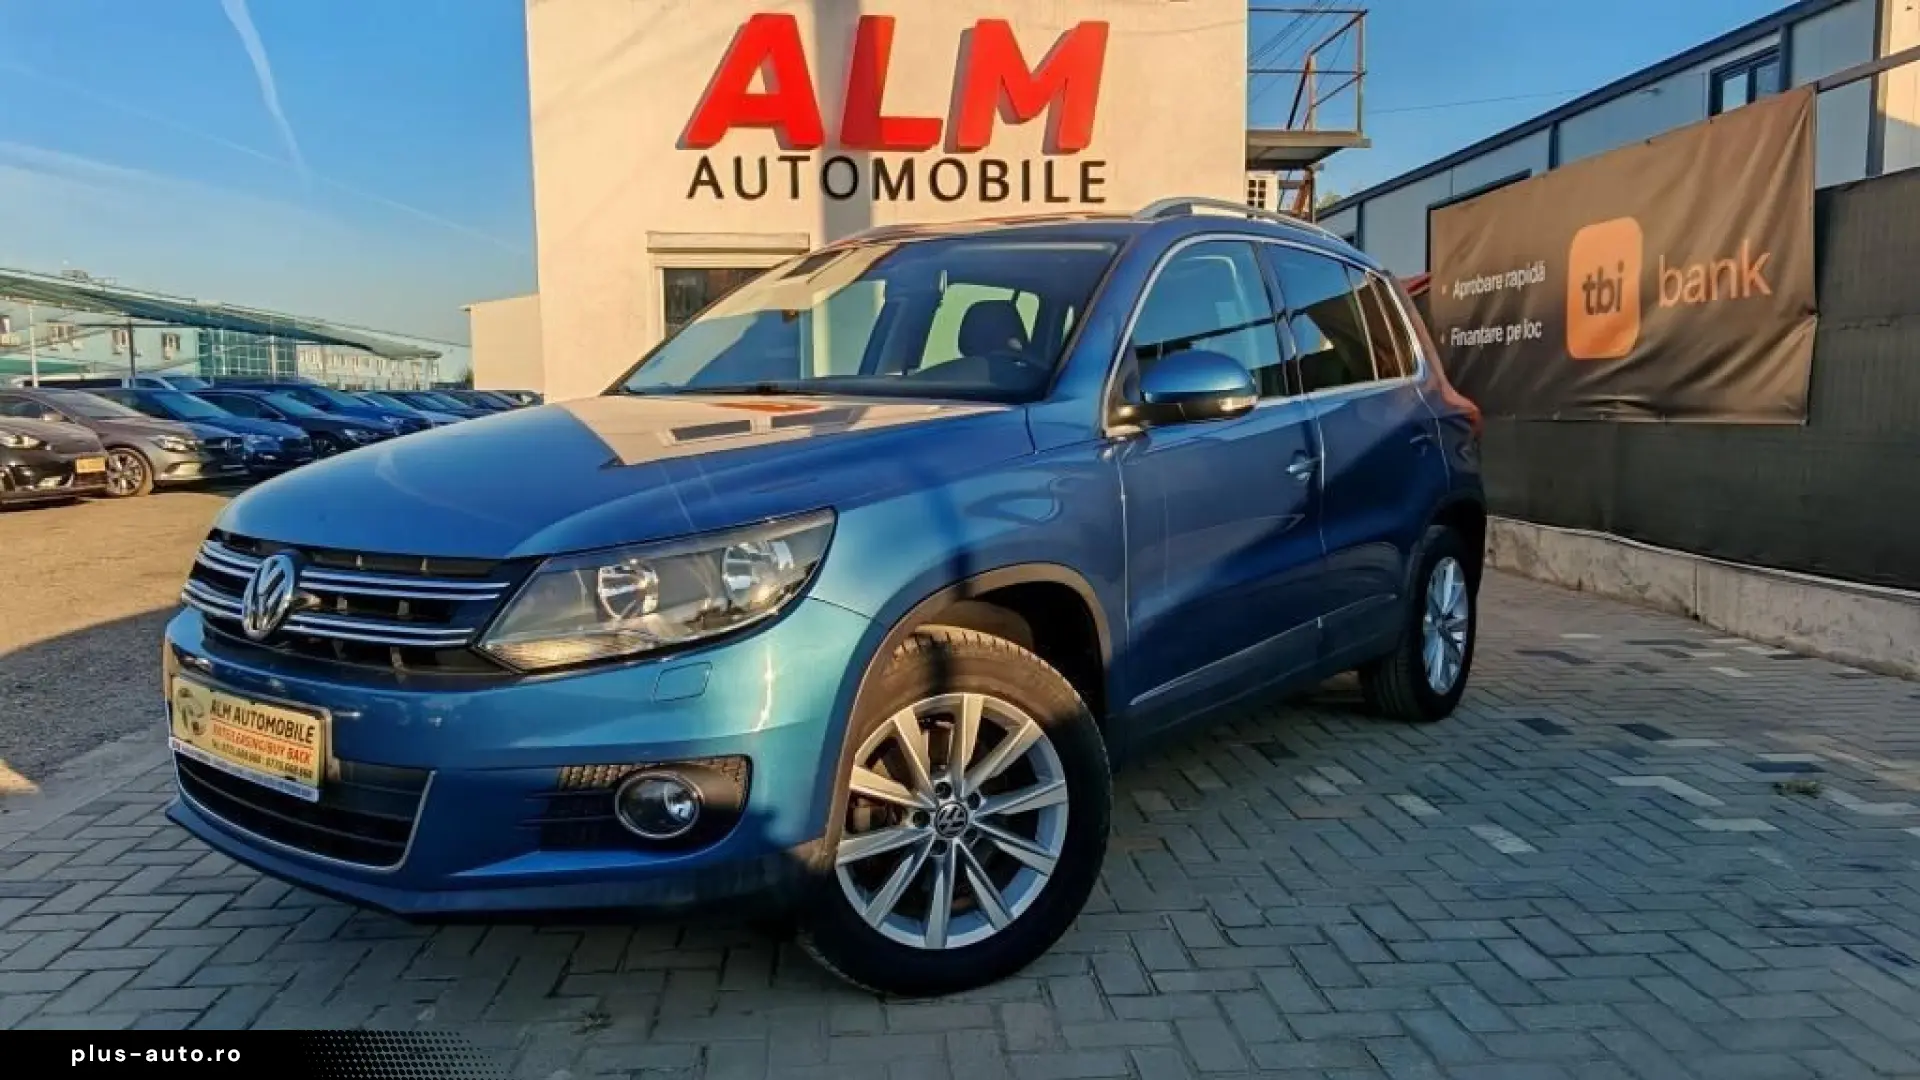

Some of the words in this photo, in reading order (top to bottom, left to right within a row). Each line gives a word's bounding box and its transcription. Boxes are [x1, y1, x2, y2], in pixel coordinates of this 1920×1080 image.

[680, 13, 1109, 152] ALM
[687, 155, 1106, 203] AUTOMOBILE
[1452, 274, 1503, 300] Aprobare
[1581, 261, 1626, 316] tbi
[1658, 239, 1772, 308] bank
[1506, 323, 1522, 346] pe
[1522, 318, 1543, 340] loc
[210, 698, 232, 721] ALM
[233, 706, 316, 744] AUTOMOBILE
